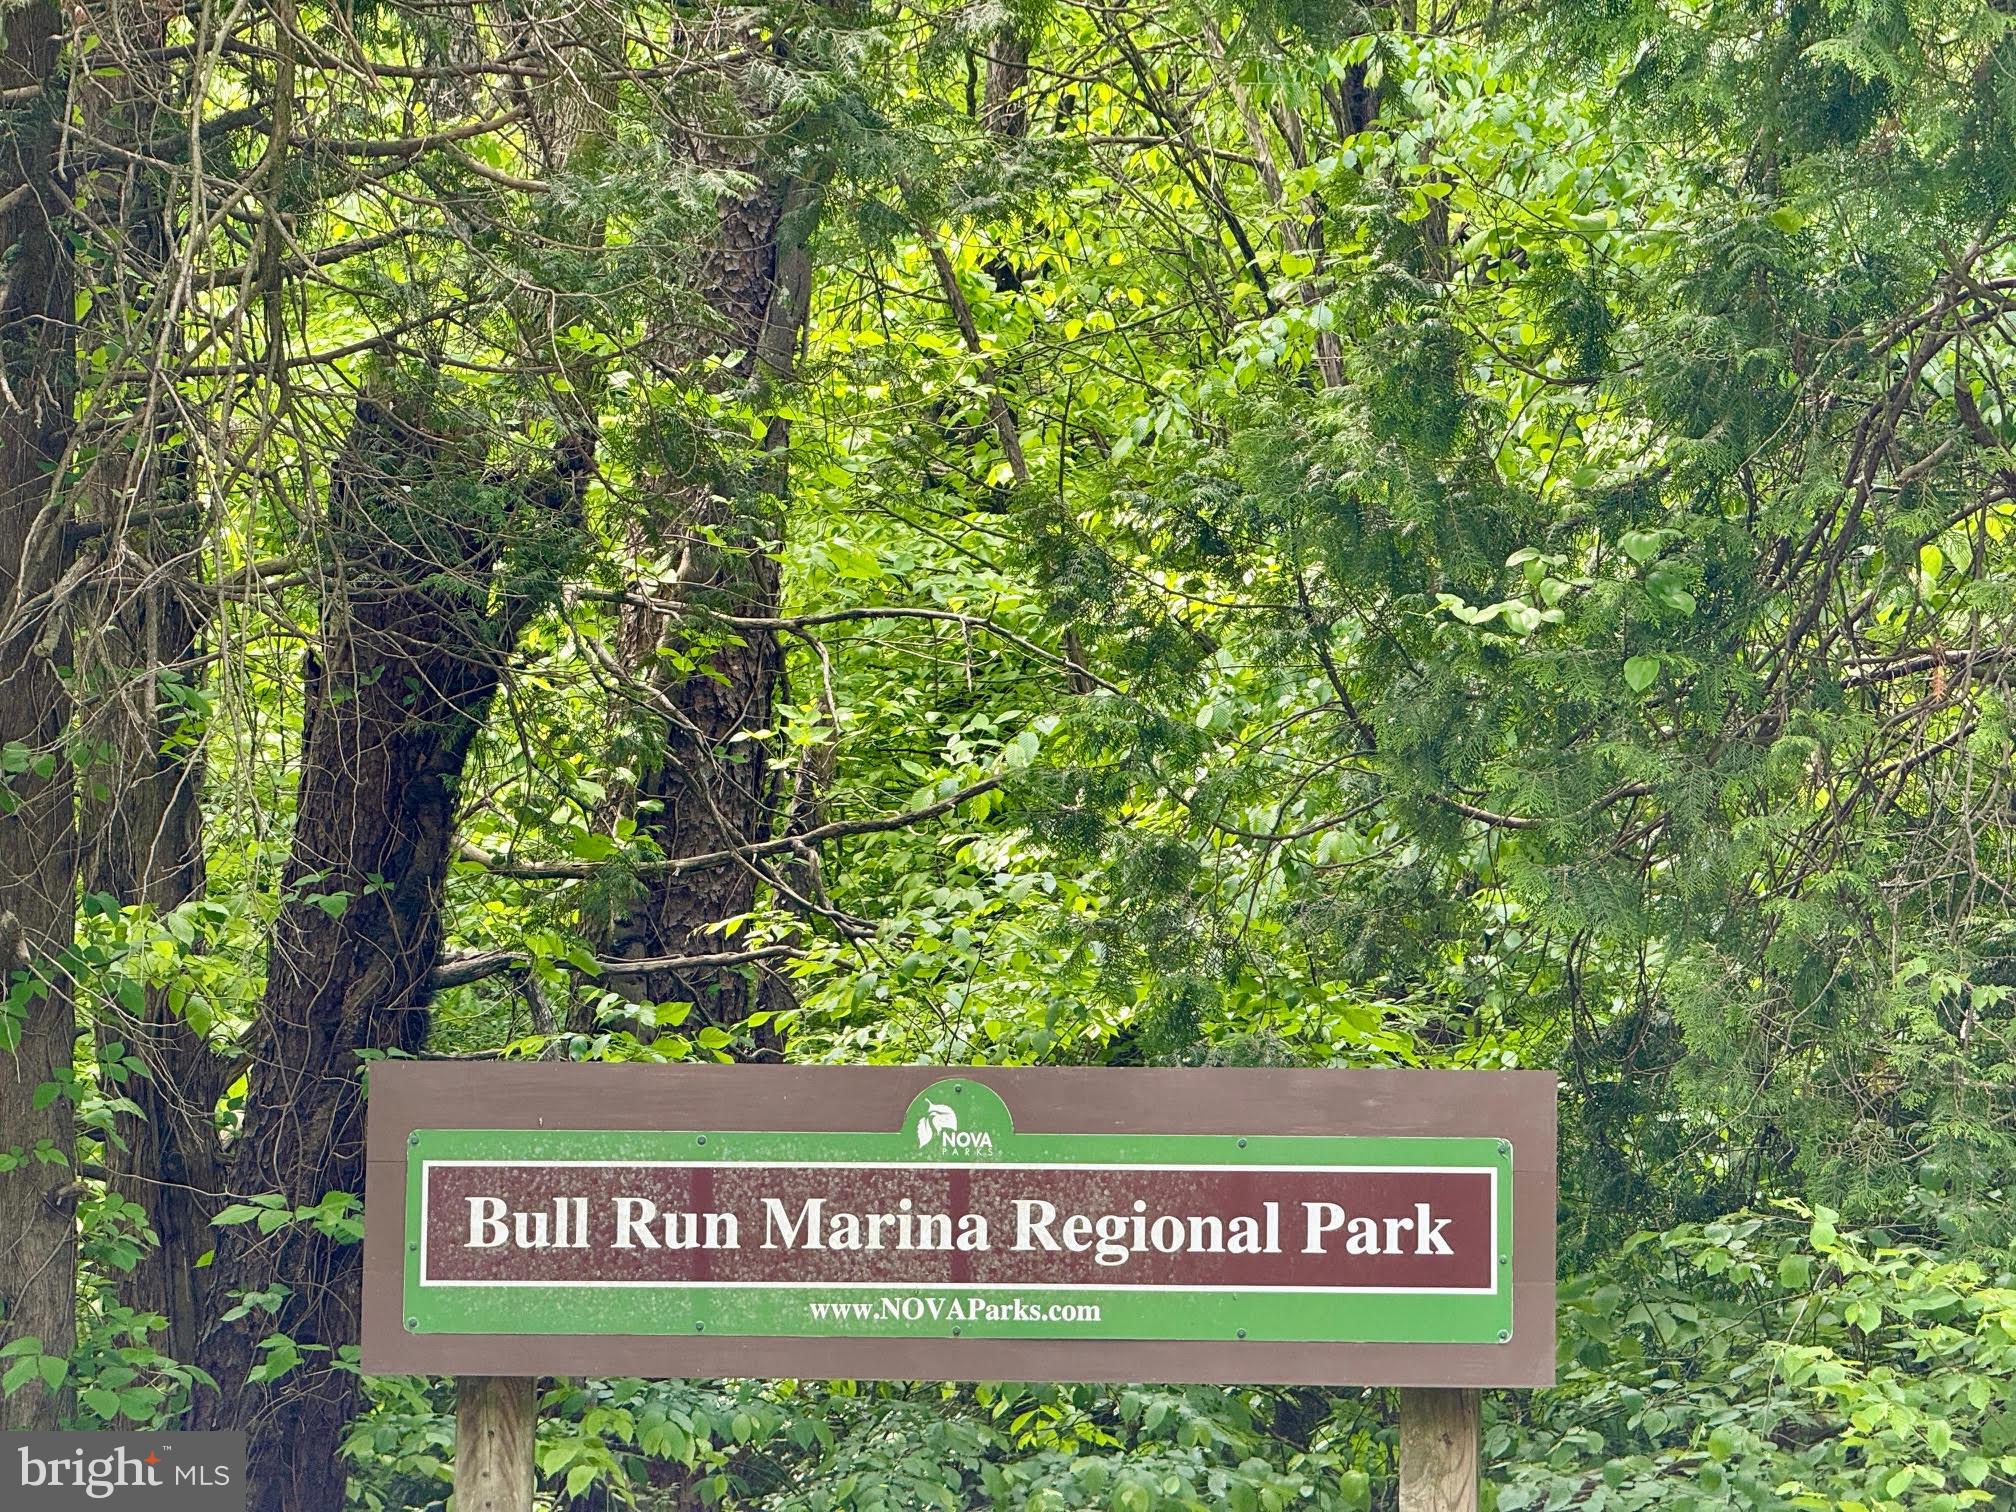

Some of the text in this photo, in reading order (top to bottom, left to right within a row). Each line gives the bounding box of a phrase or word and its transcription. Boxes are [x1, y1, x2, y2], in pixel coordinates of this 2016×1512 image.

[942, 1131, 993, 1148] NOVA
[942, 1147, 993, 1156] PARKS
[464, 1196, 1455, 1267] Bull Run Marina Regional Park
[809, 1298, 1102, 1322] www.NOVAParks.com
